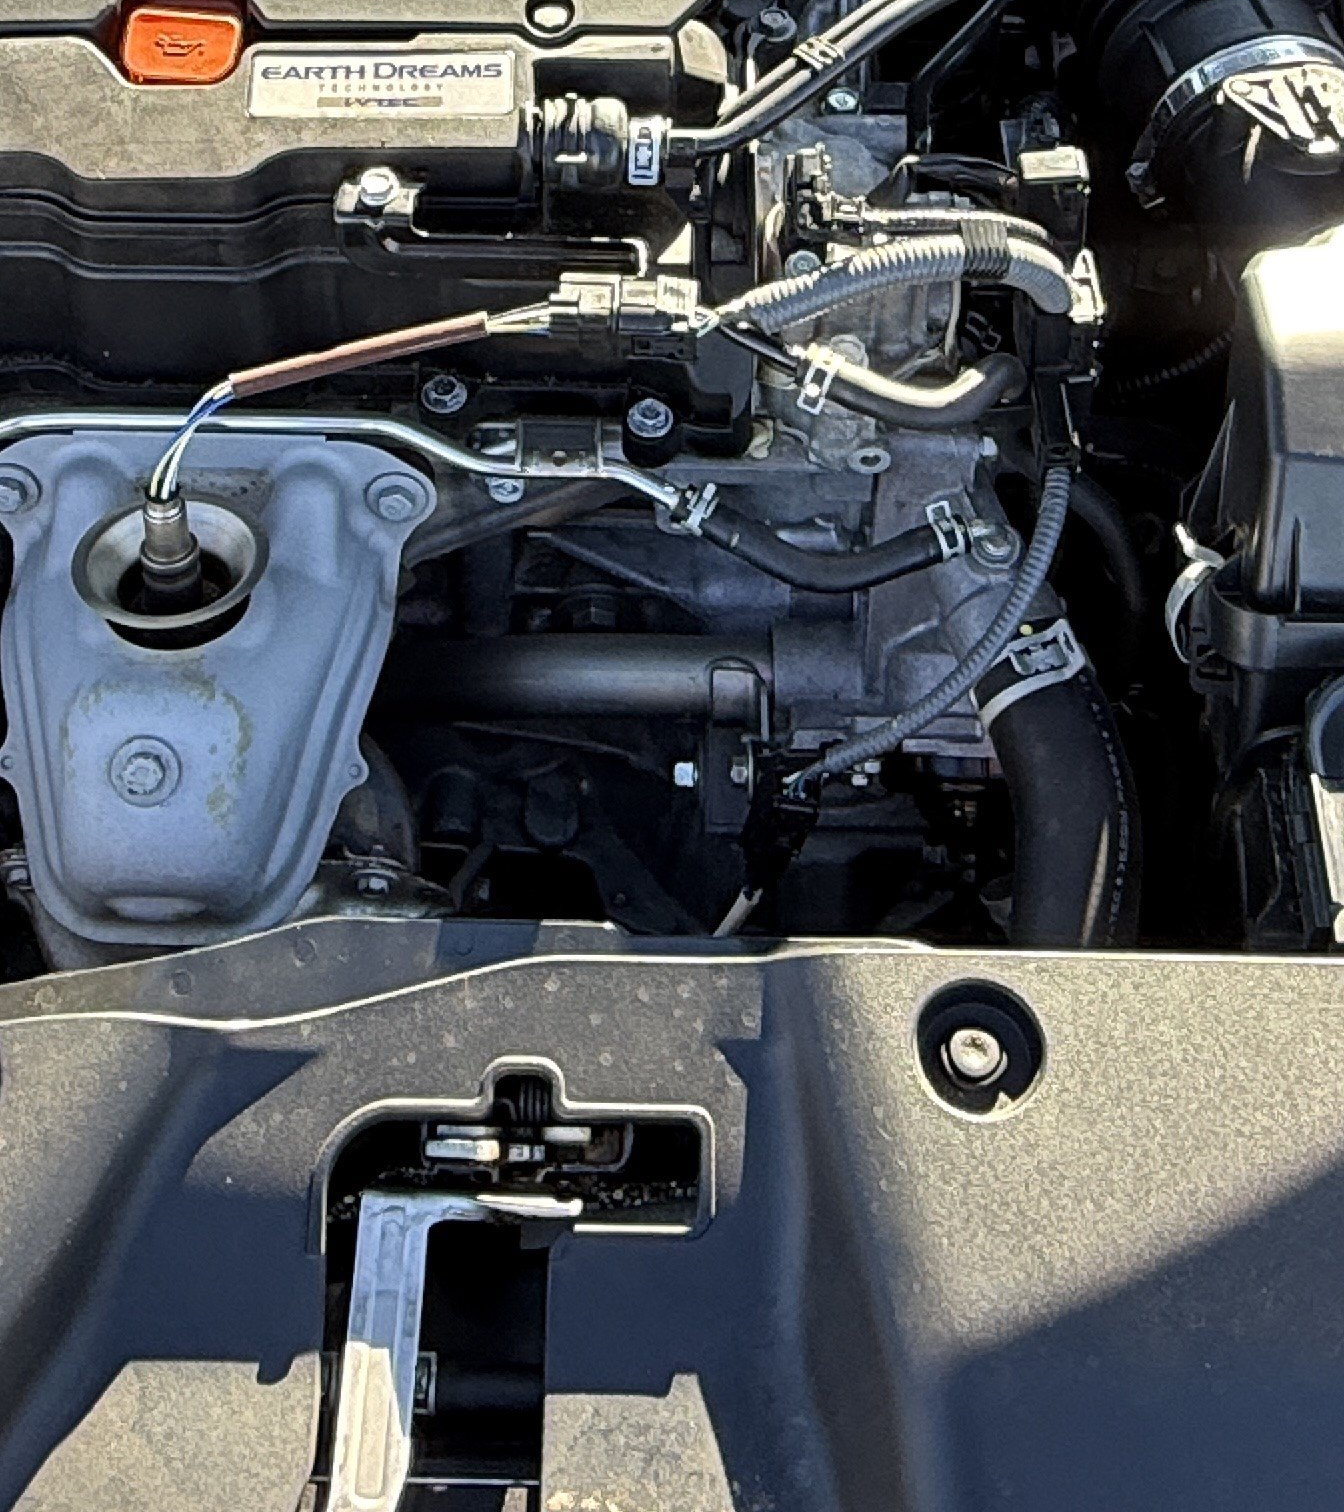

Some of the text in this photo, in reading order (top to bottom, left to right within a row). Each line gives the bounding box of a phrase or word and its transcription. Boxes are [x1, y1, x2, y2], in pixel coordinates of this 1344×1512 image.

[261, 62, 502, 80] EARTH DREAMS
[318, 83, 444, 93] TECHNOLOGY
